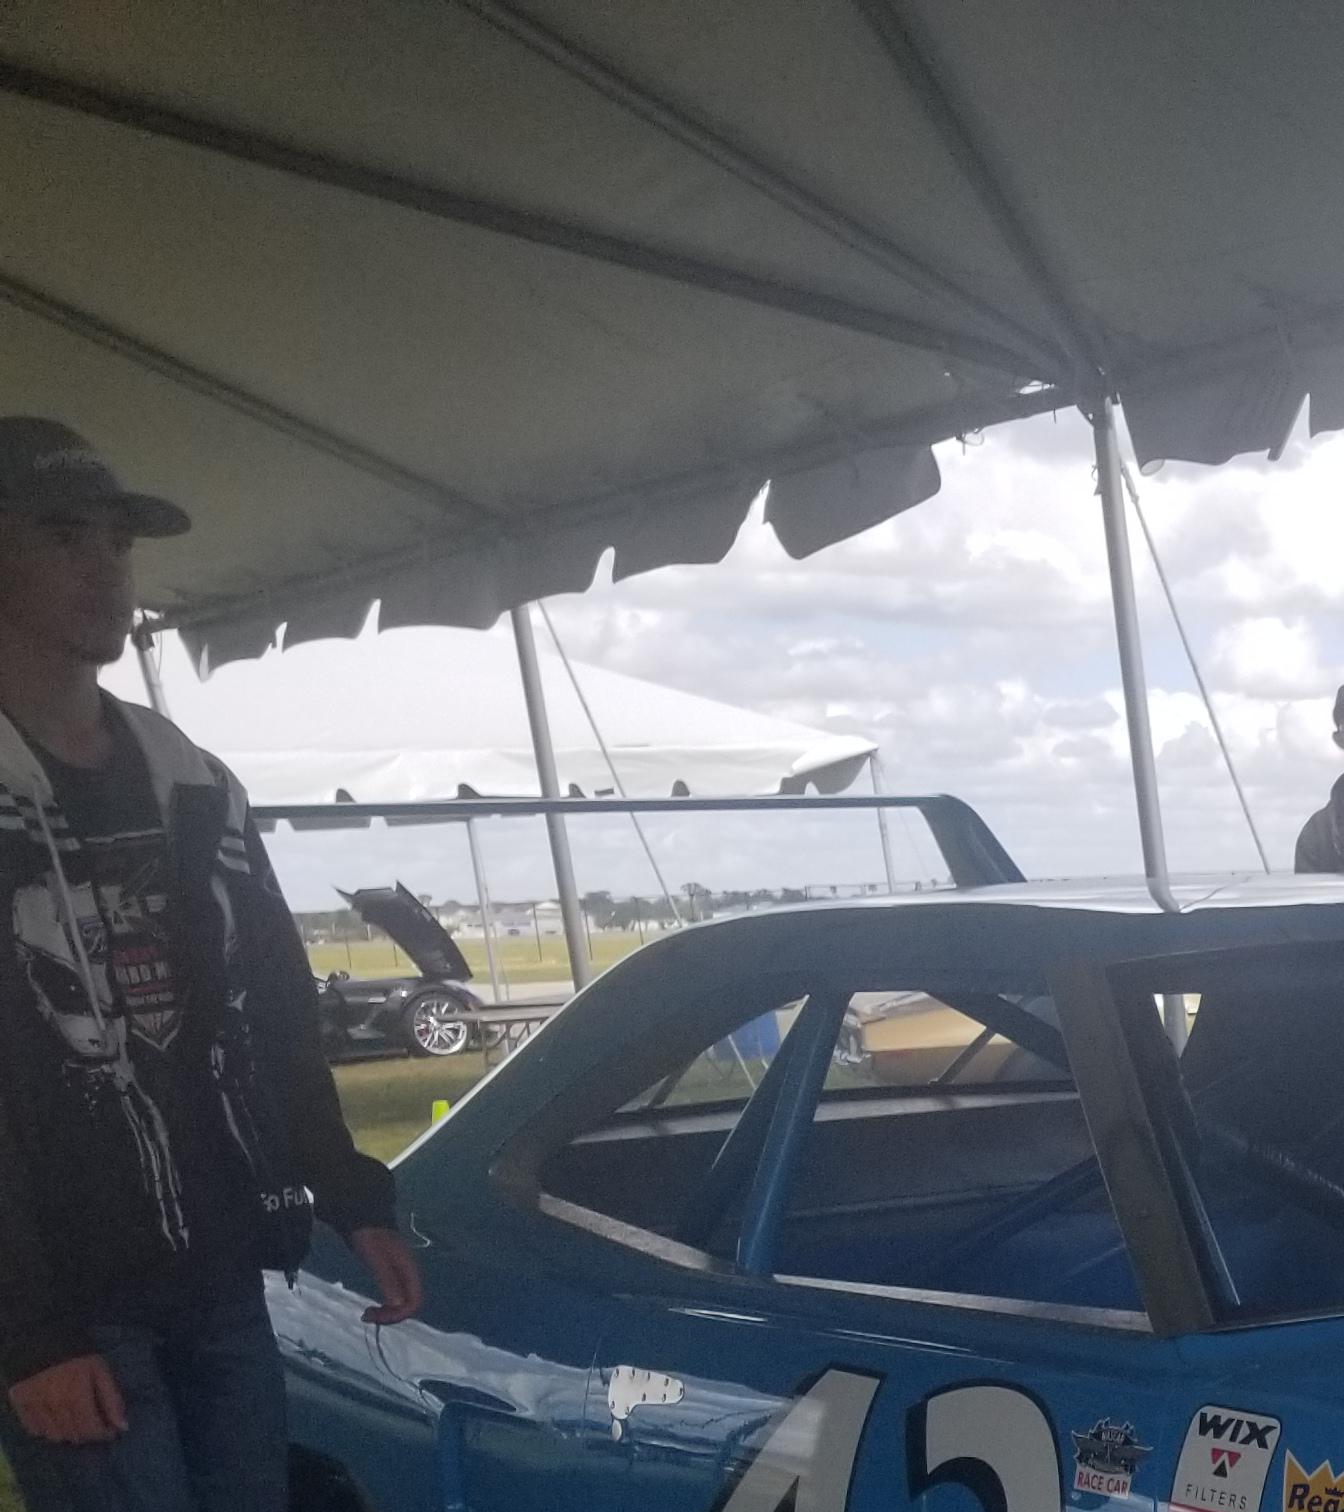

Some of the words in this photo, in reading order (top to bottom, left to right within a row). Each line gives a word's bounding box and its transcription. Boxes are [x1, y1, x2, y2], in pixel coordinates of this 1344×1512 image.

[1199, 1412, 1279, 1449] WIX
[1077, 1471, 1104, 1490] RACE
[1106, 1478, 1128, 1496] CAR
[1186, 1484, 1248, 1510] FILTERS
